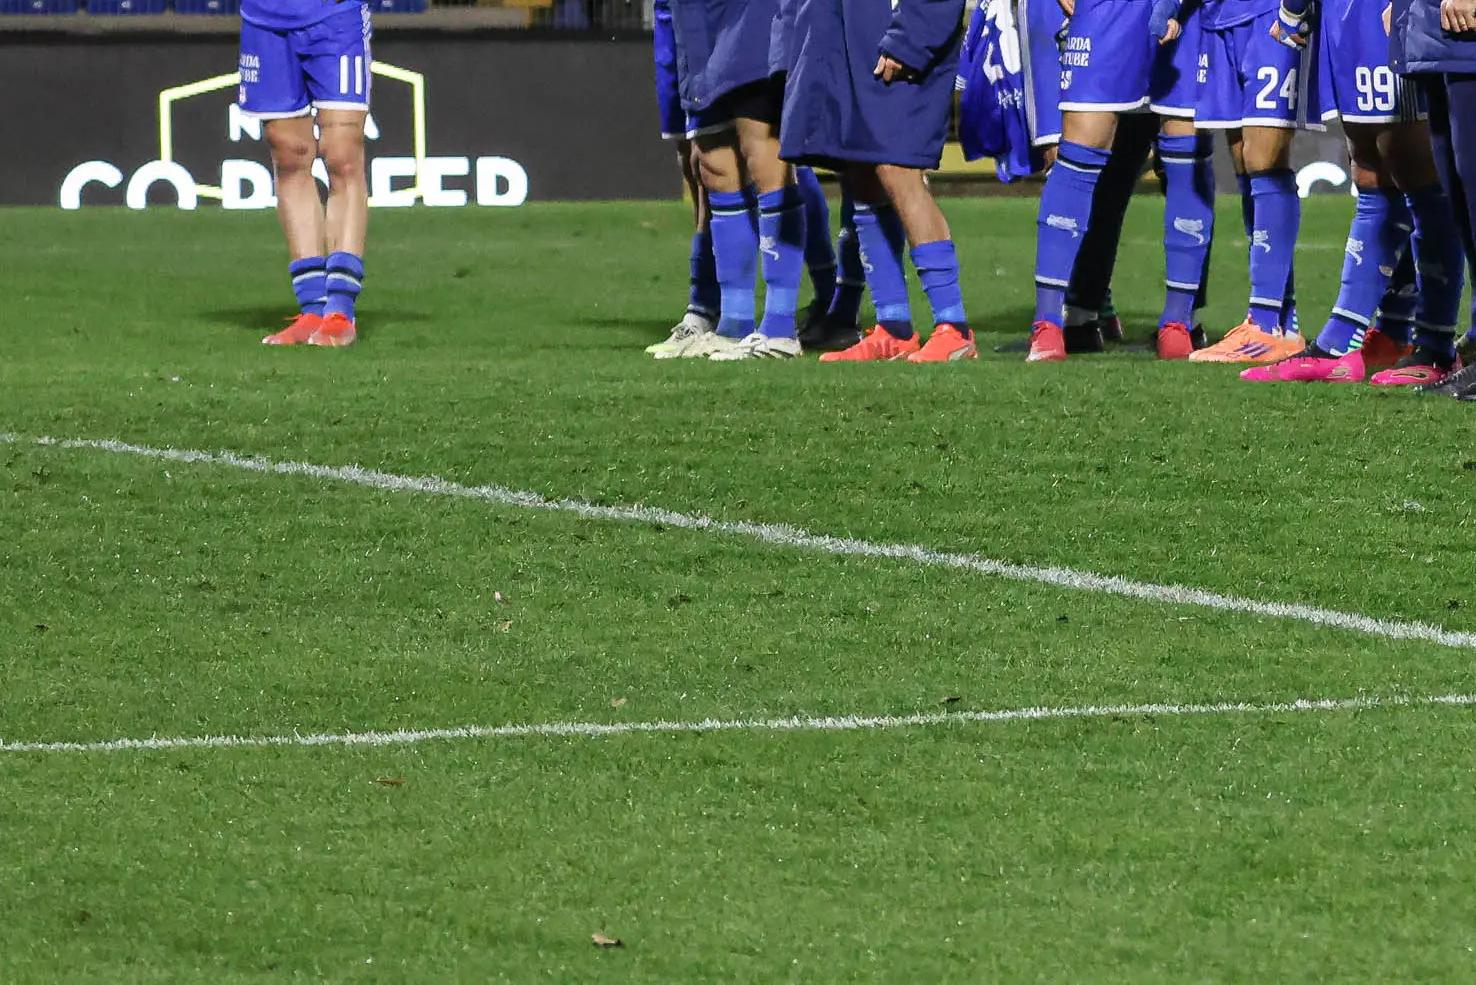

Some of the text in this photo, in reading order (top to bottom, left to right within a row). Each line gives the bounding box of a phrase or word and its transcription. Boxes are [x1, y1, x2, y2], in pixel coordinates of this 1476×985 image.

[339, 54, 363, 96] 11
[1255, 66, 1298, 111] 24
[1355, 65, 1395, 112] 99
